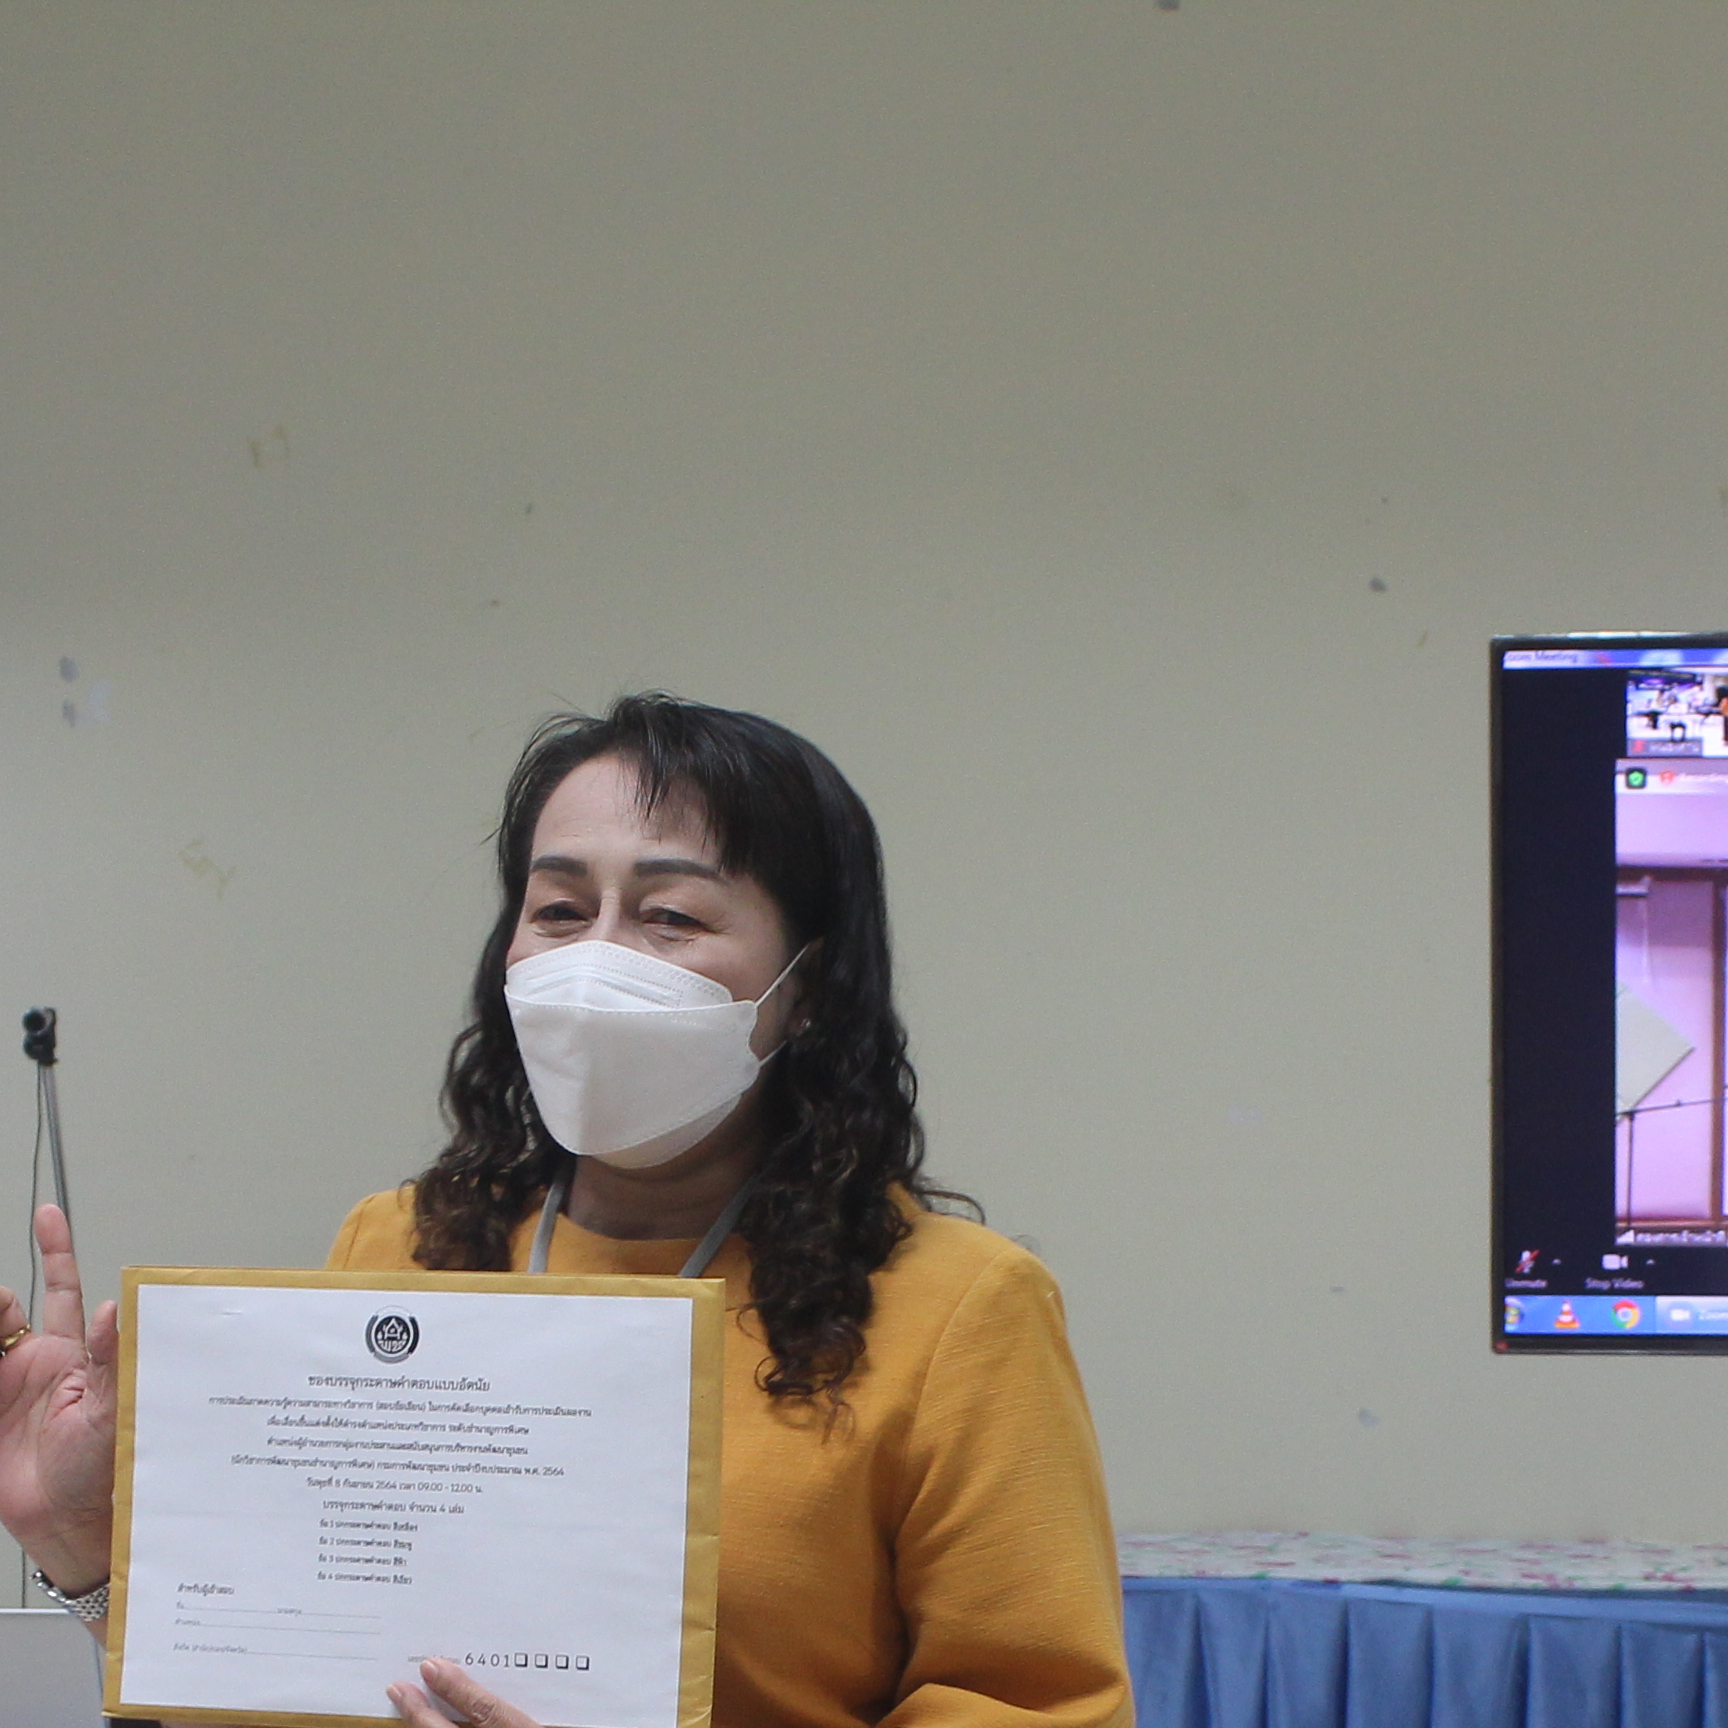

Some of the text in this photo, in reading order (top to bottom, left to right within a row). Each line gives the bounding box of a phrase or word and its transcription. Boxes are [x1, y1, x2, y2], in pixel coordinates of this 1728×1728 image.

[1585, 1277, 1645, 1290] Stop Video
[308, 1374, 491, 1393] ซองบรรจุกระดาษคำตอบแบบอัตนัย
[542, 1466, 565, 1477] 2564
[334, 1478, 342, 1488] 8
[375, 1480, 398, 1490] 2564
[417, 1482, 443, 1492] 09.00
[450, 1483, 473, 1493] 12.00
[322, 1499, 407, 1513] บรรจุกระดาษคำตอบ
[408, 1501, 437, 1513] จำนวน
[439, 1503, 446, 1513] 4
